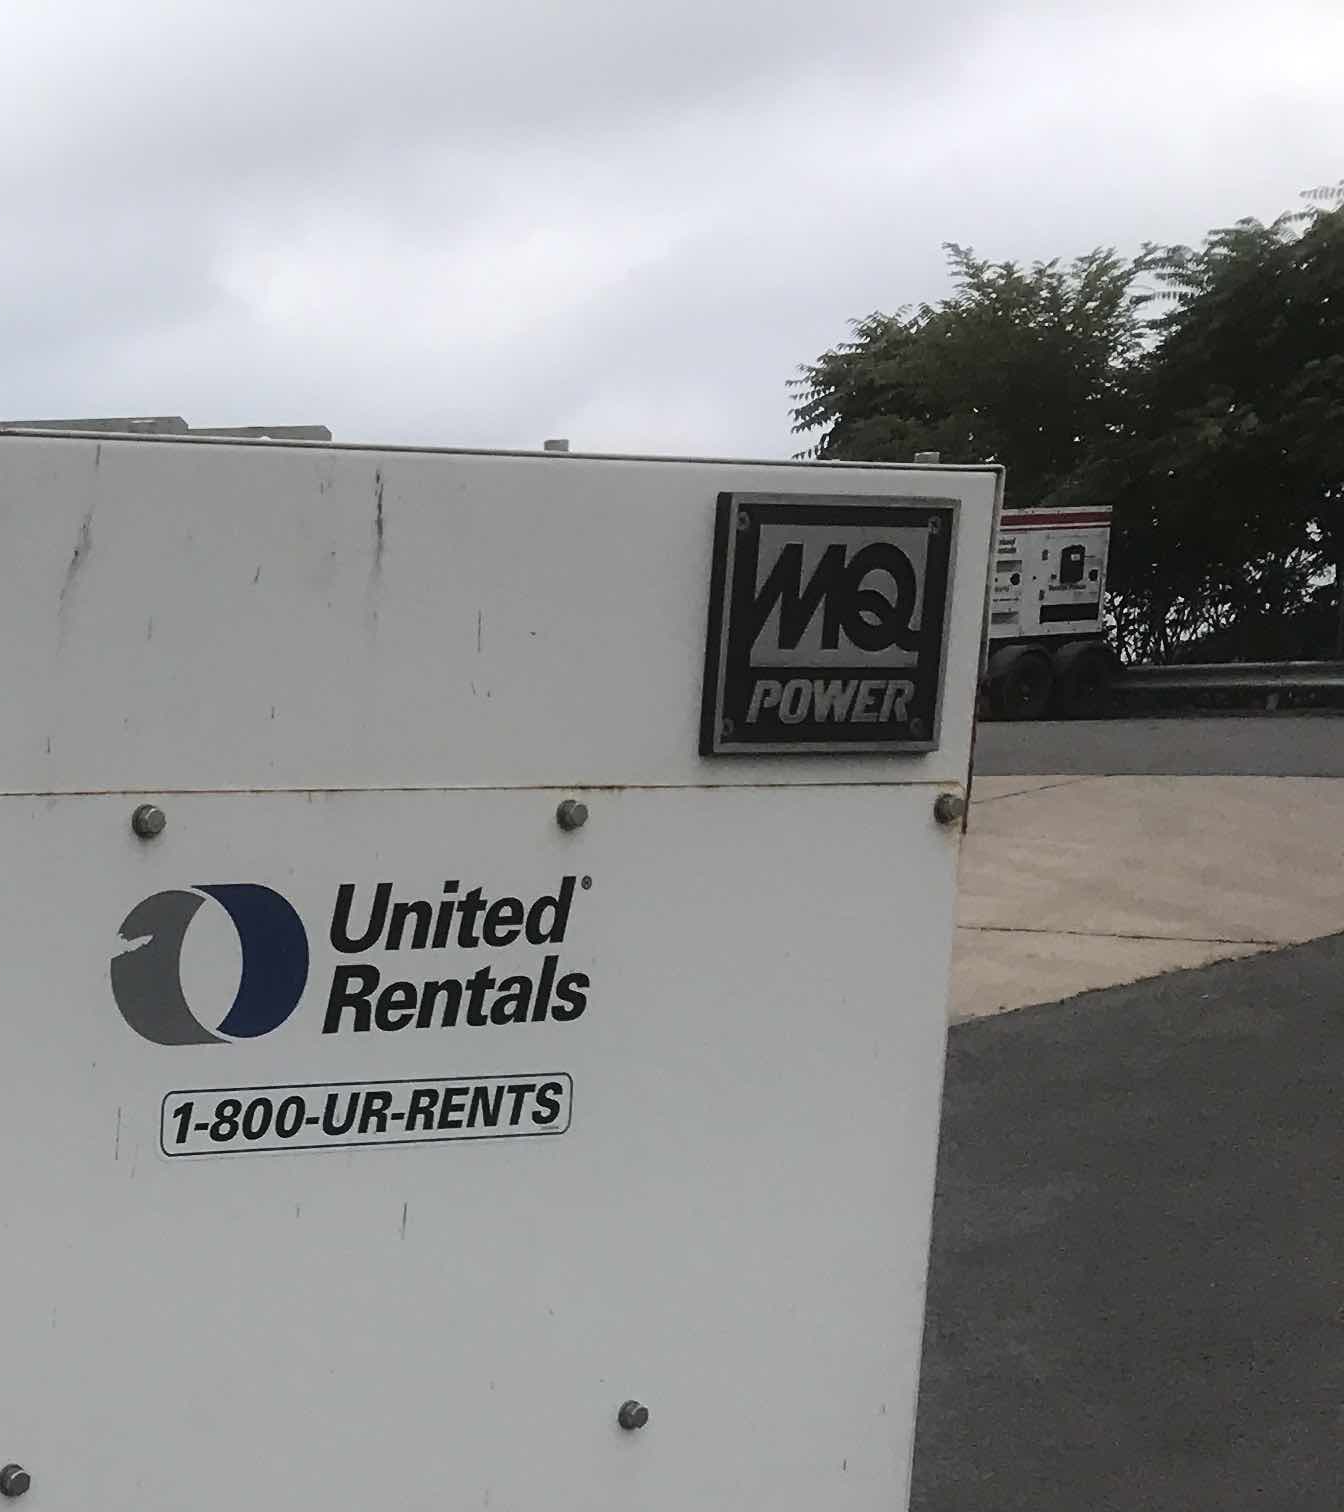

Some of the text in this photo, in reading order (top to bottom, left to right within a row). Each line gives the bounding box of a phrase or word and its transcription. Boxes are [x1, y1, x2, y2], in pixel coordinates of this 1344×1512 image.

[749, 542, 919, 652] MQ
[745, 678, 919, 725] POWER
[329, 875, 577, 954] United
[321, 954, 591, 1035] Rentals
[171, 1081, 564, 1145] 1-800-UR-RENTS
